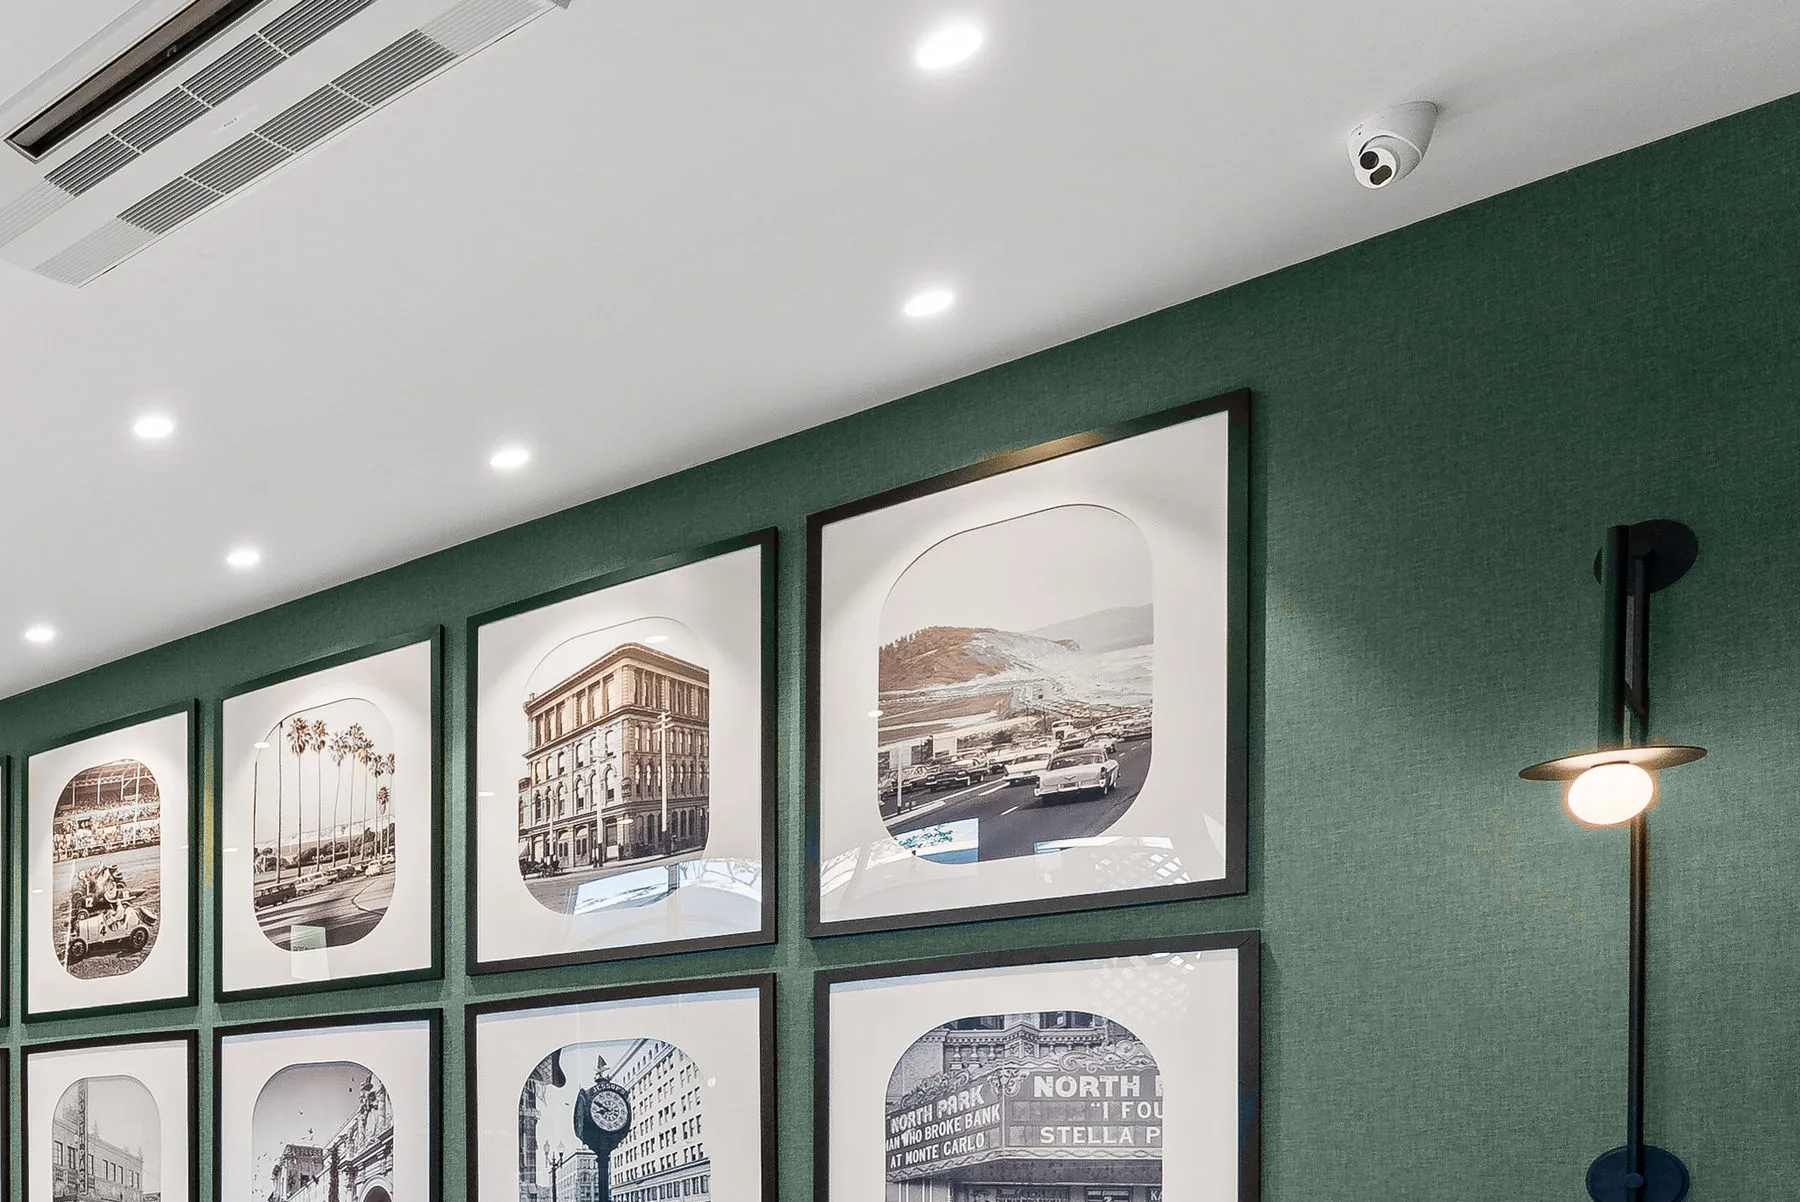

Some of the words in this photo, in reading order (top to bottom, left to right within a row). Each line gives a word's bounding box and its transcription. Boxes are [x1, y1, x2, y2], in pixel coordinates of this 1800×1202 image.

[99, 925, 107, 937] 4
[1033, 1074, 1141, 1098] NORTH
[890, 1103, 933, 1134] NORTH
[936, 1084, 985, 1119] PARK
[901, 1129, 923, 1147] WHO
[924, 1116, 962, 1141] BROKE
[964, 1103, 1001, 1129] BANK
[1039, 1126, 1134, 1144] STELLA
[890, 1153, 902, 1169] AT
[905, 1143, 940, 1165] MONTE
[943, 1132, 985, 1156] CARLO
